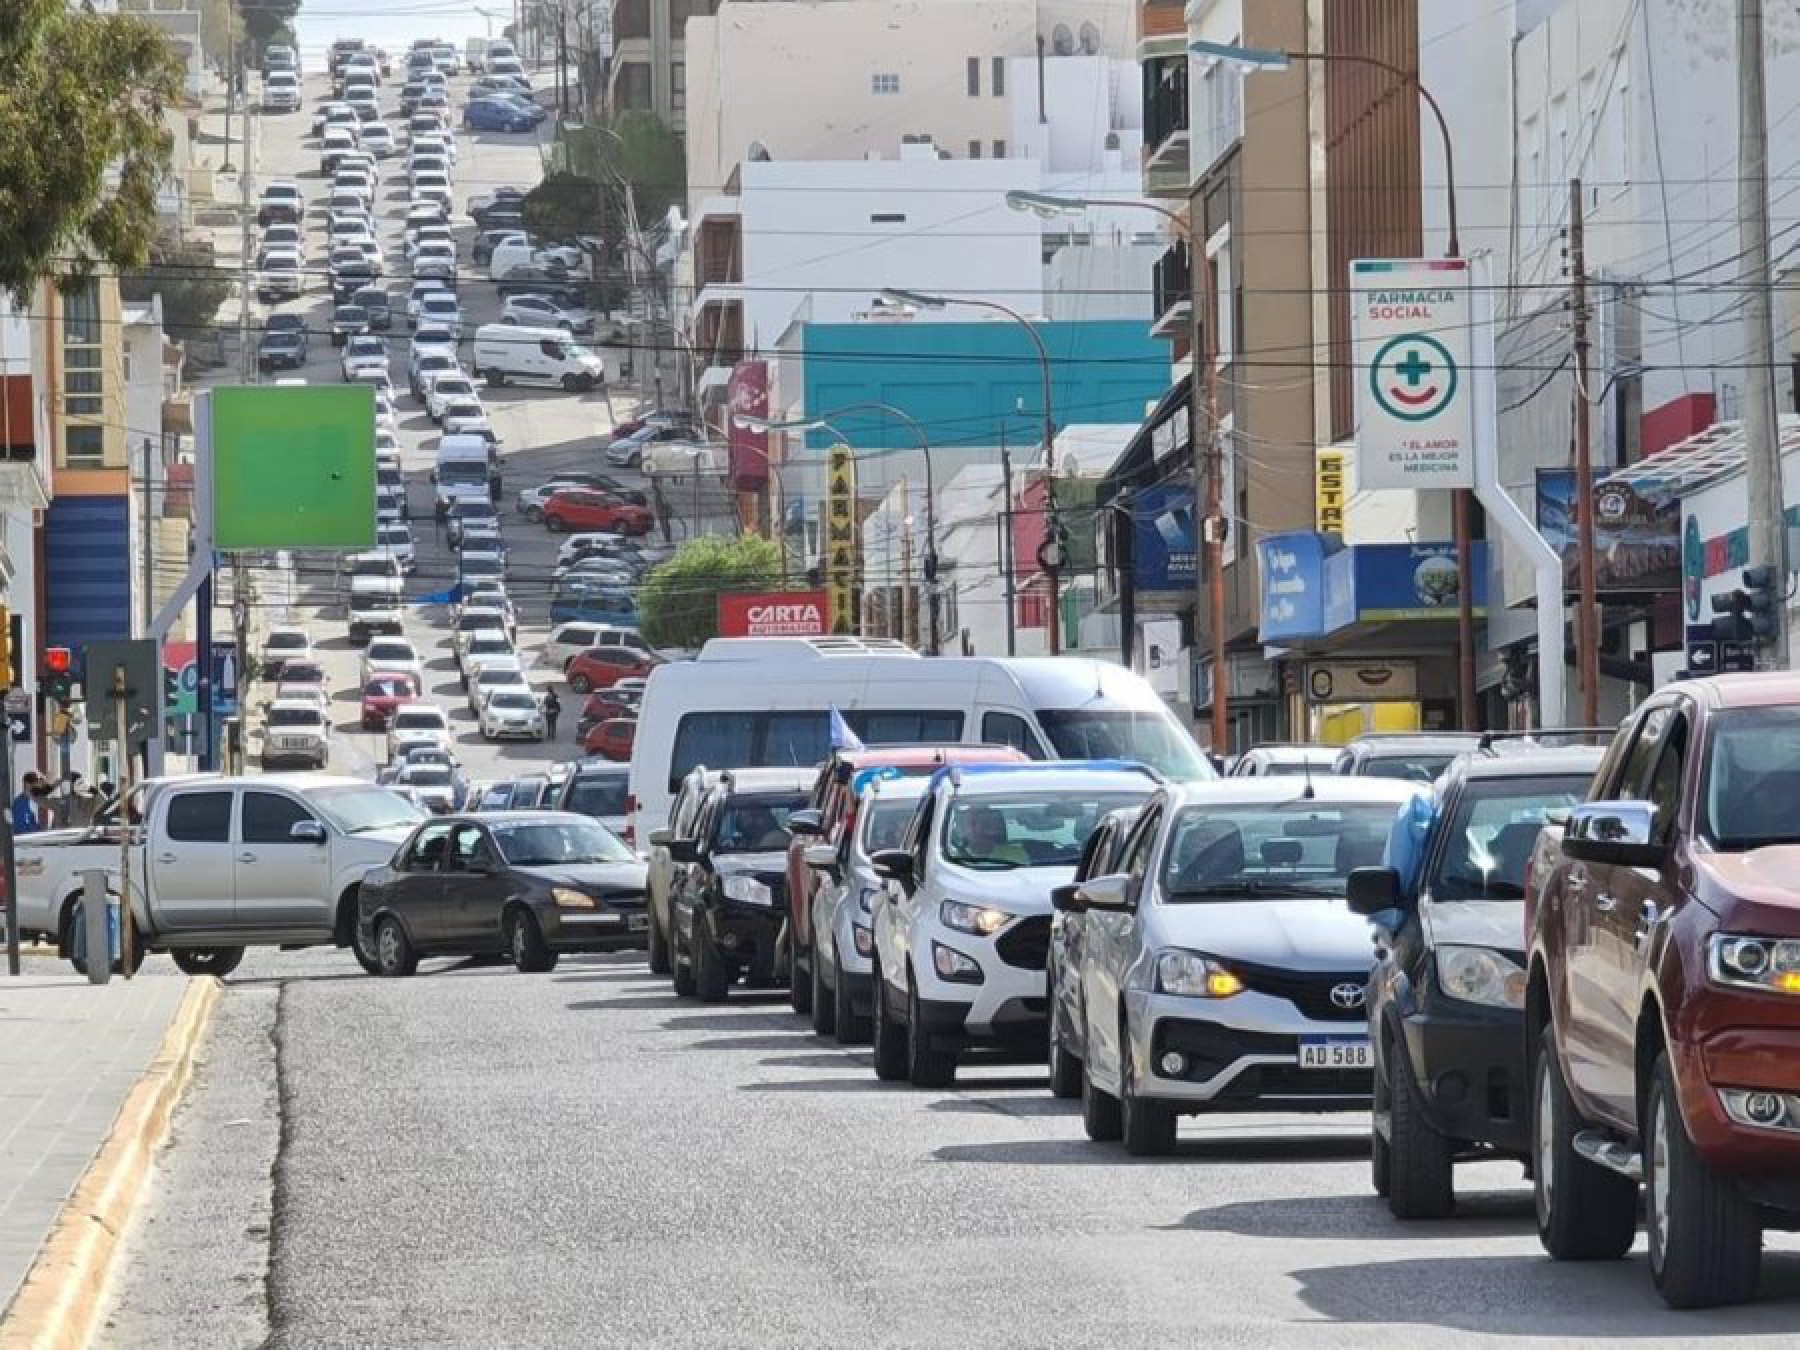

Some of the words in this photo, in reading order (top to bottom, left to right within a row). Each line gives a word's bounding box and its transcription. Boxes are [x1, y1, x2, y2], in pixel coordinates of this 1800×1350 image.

[1367, 291, 1455, 304] FARMACIA
[1369, 306, 1432, 319] SOCIAL
[1424, 440, 1459, 449] AMOR
[1421, 451, 1459, 461] MEJOR
[1403, 463, 1459, 473] MEDICINA
[747, 604, 821, 622] CARTA
[1305, 1047, 1327, 1065] AD
[1333, 1047, 1367, 1065] 588
